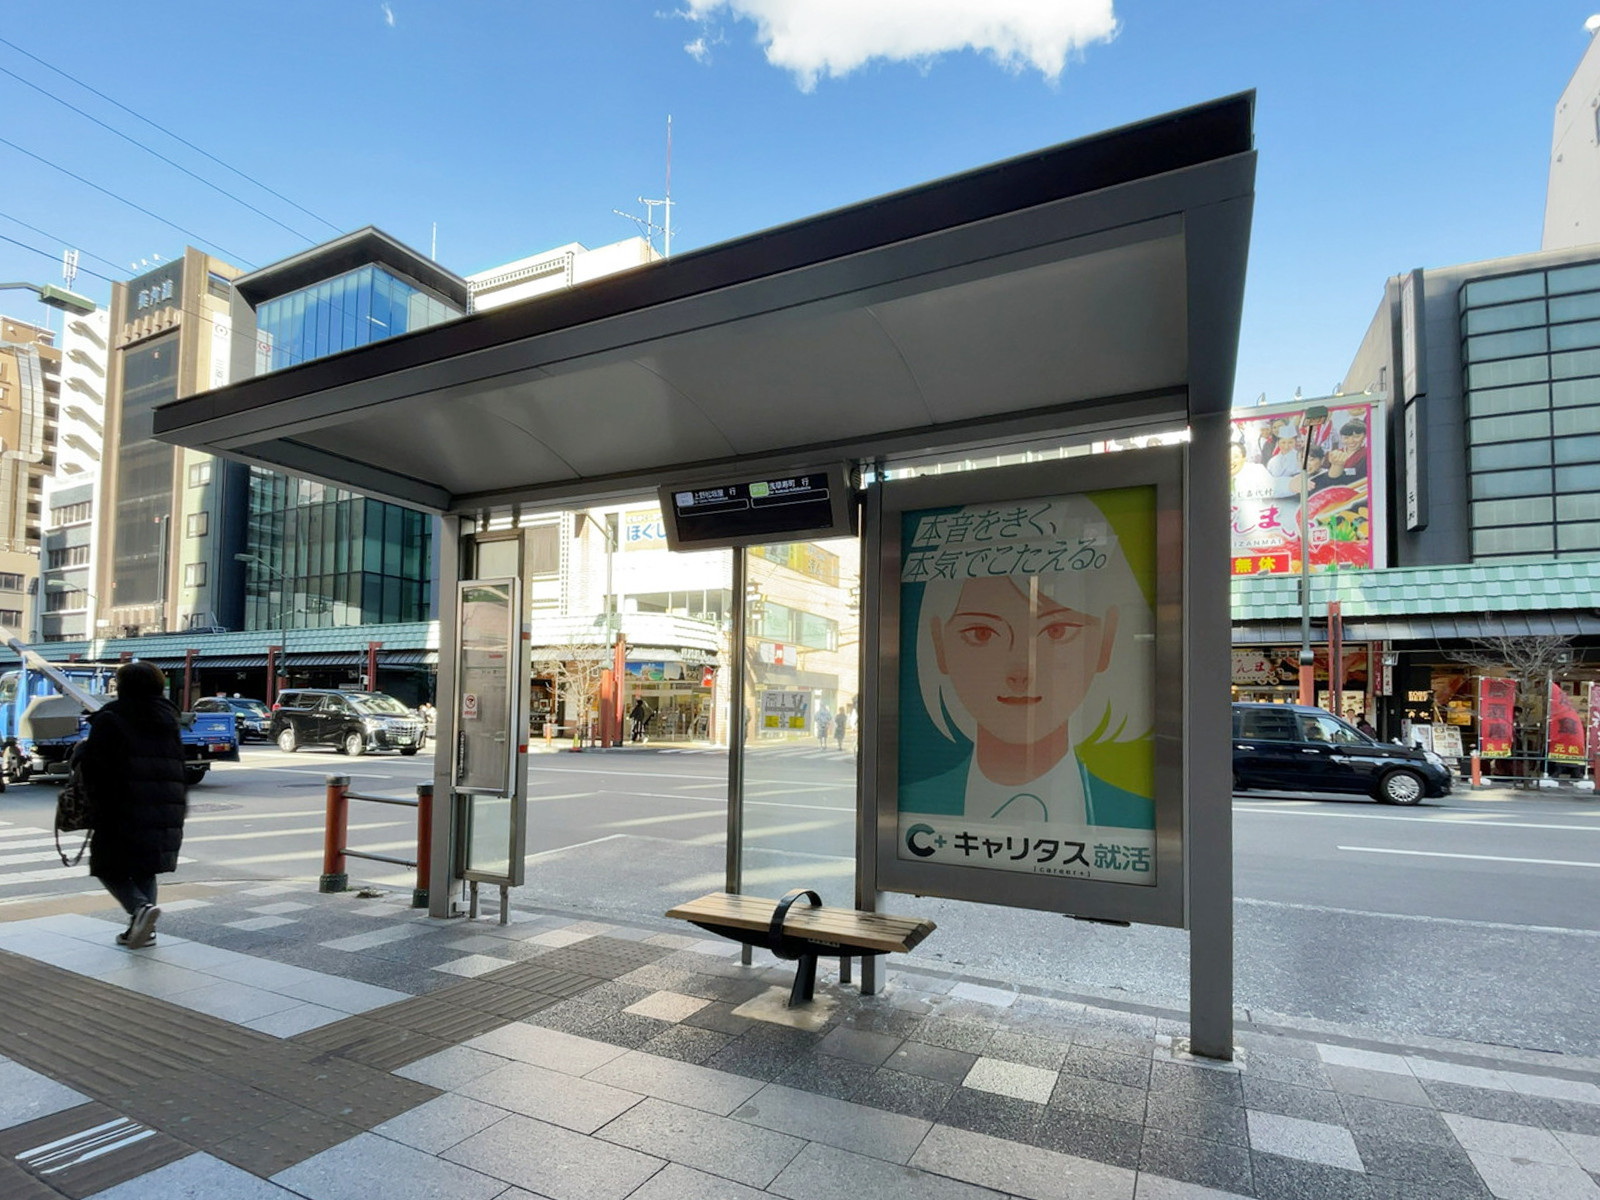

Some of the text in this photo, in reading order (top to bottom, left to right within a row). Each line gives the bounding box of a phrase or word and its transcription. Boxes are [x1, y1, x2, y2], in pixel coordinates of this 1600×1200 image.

[729, 487, 736, 496] 行
[801, 478, 809, 487] 行
[916, 503, 1057, 545] 本音をきく、
[903, 538, 1107, 581] 本気でこたえる。
[954, 831, 1089, 867] キャリタス
[1093, 843, 1151, 872] 就活
